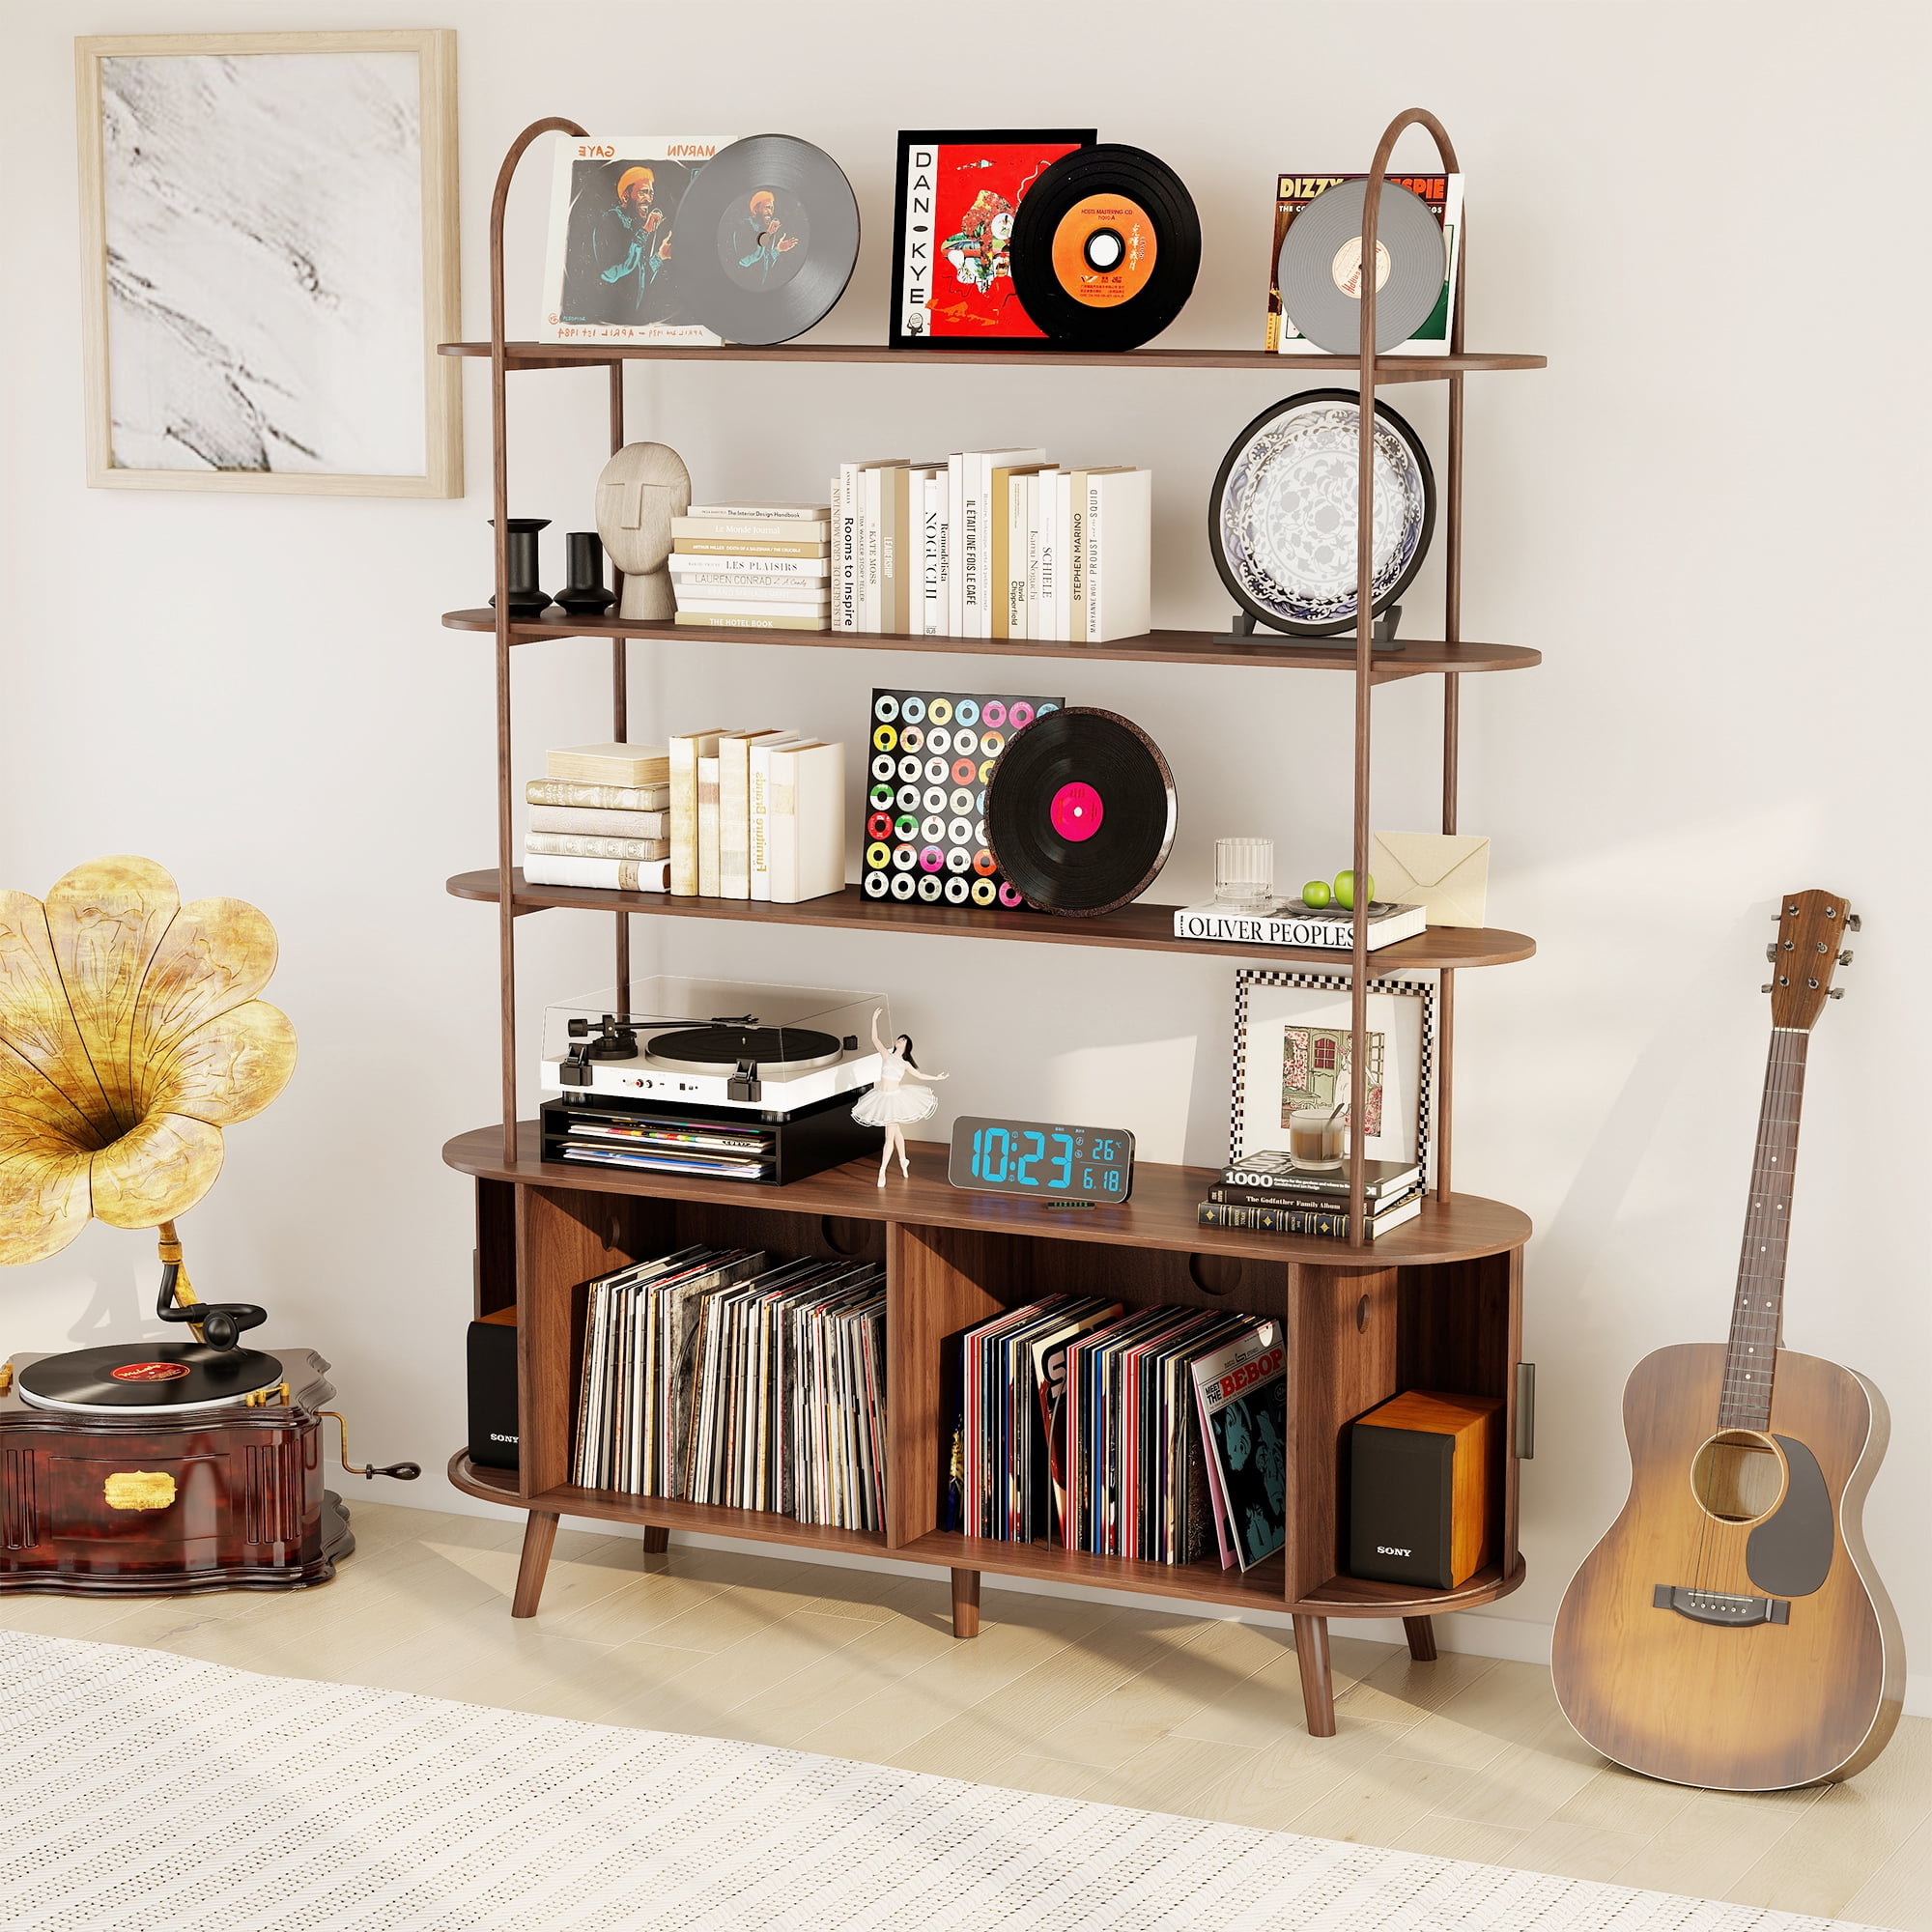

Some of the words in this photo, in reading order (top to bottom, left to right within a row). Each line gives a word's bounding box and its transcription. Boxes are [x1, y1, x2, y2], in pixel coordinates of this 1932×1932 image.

[913, 152, 932, 213] DAN
[910, 242, 928, 304] KYE
[725, 525, 752, 533] Monde
[753, 526, 781, 534] Journal
[844, 518, 854, 560] Rooms
[966, 534, 976, 550] UNE
[1030, 530, 1038, 557] Isamu
[925, 512, 937, 599] NOGUCHI
[940, 524, 949, 582] Remodelista
[966, 551, 976, 570] FOIS
[725, 561, 745, 570] LES
[749, 561, 798, 572] PLAISIRS
[834, 565, 840, 577] DE
[844, 565, 854, 578] to
[966, 572, 976, 582] LE
[1042, 547, 1052, 599] SCHIELE
[695, 574, 732, 584] LAUREN
[734, 575, 772, 586] CONRAD
[1029, 560, 1038, 600] Noguchi
[842, 582, 855, 626] Inspire
[966, 583, 977, 606] CAFÉ
[725, 618, 750, 627] HOTEL
[1188, 917, 1263, 941] OLIVER
[1268, 922, 1354, 948] PEOPLES
[971, 1127, 1074, 1189] 10:23
[1092, 1138, 1114, 1161] 26
[1225, 1171, 1273, 1187] 1000
[1261, 1197, 1294, 1206] Godfather
[1296, 1200, 1319, 1208] Family
[1319, 1201, 1341, 1210] Album
[1207, 1390, 1222, 1406] THE
[1219, 1348, 1283, 1399] BEBOP
[1205, 1381, 1219, 1395] MEET
[490, 1433, 520, 1443] SONY
[1377, 1546, 1412, 1557] SONY
